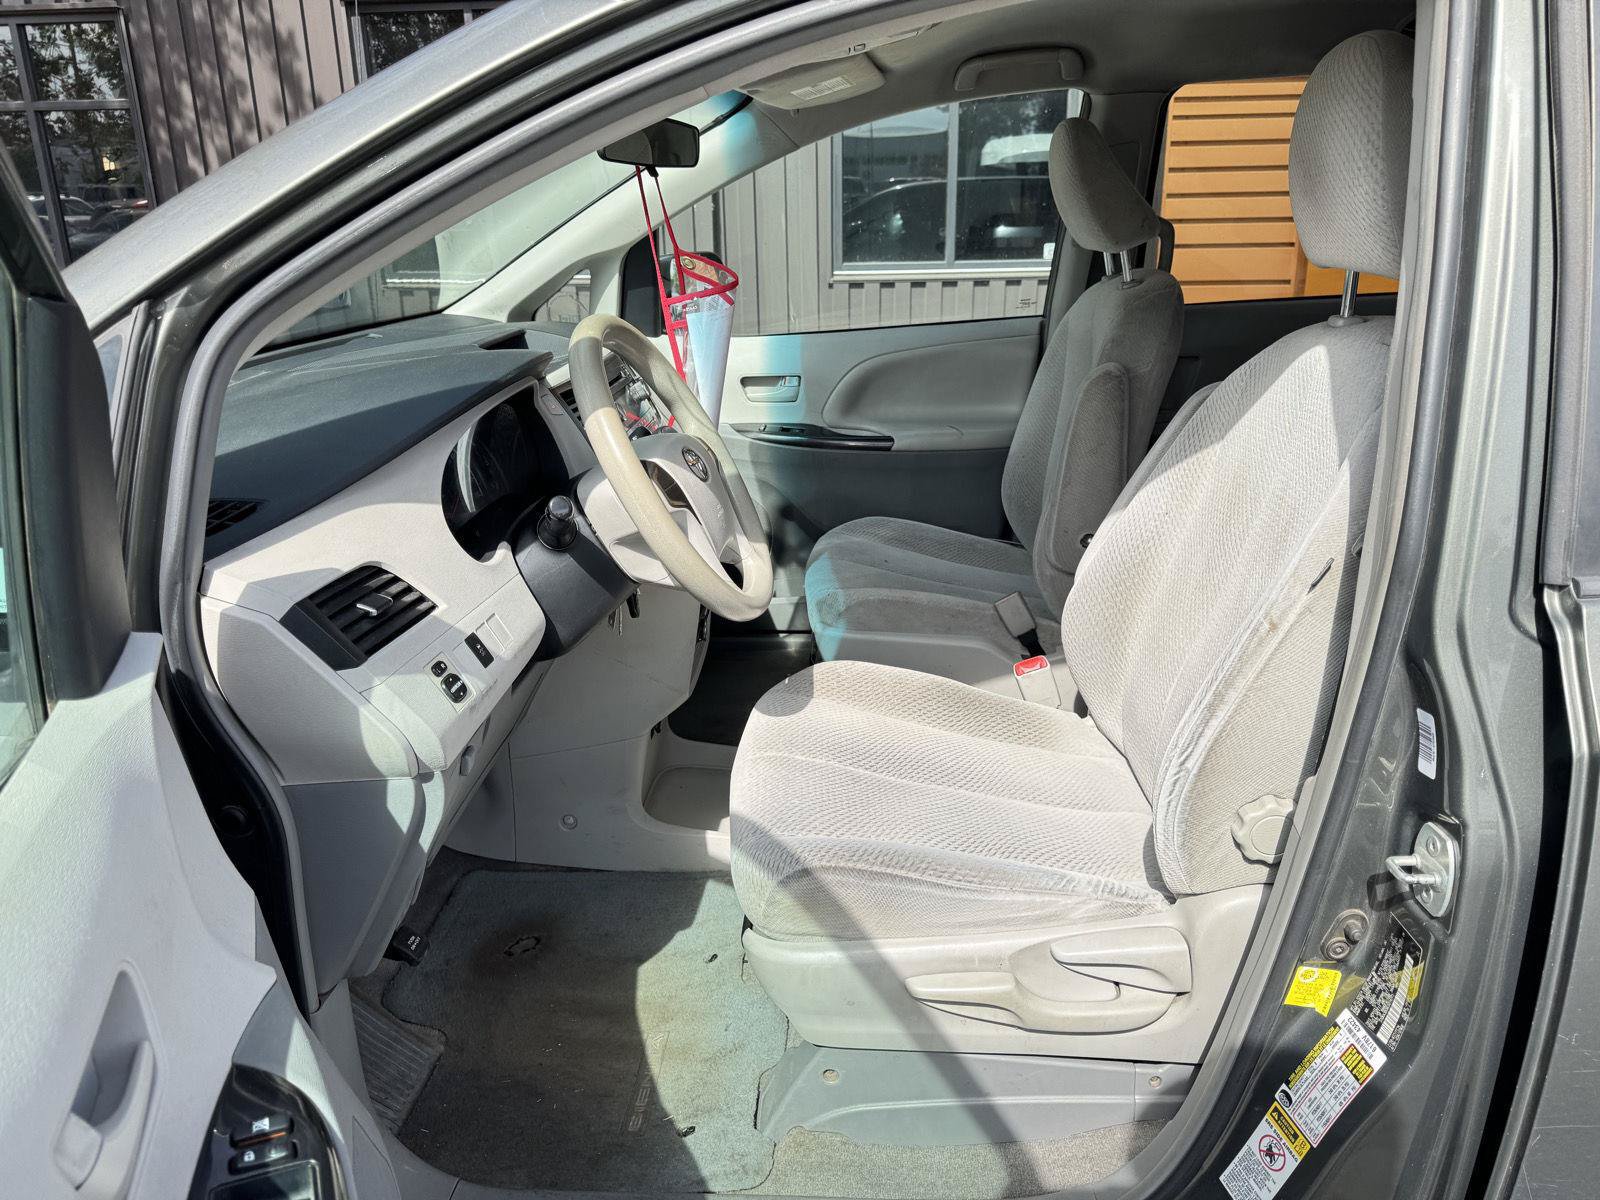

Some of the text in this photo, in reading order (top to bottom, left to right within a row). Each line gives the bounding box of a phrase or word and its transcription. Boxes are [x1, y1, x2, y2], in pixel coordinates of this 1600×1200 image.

[1264, 1117, 1299, 1162] SRS SIDE AIRBAG
